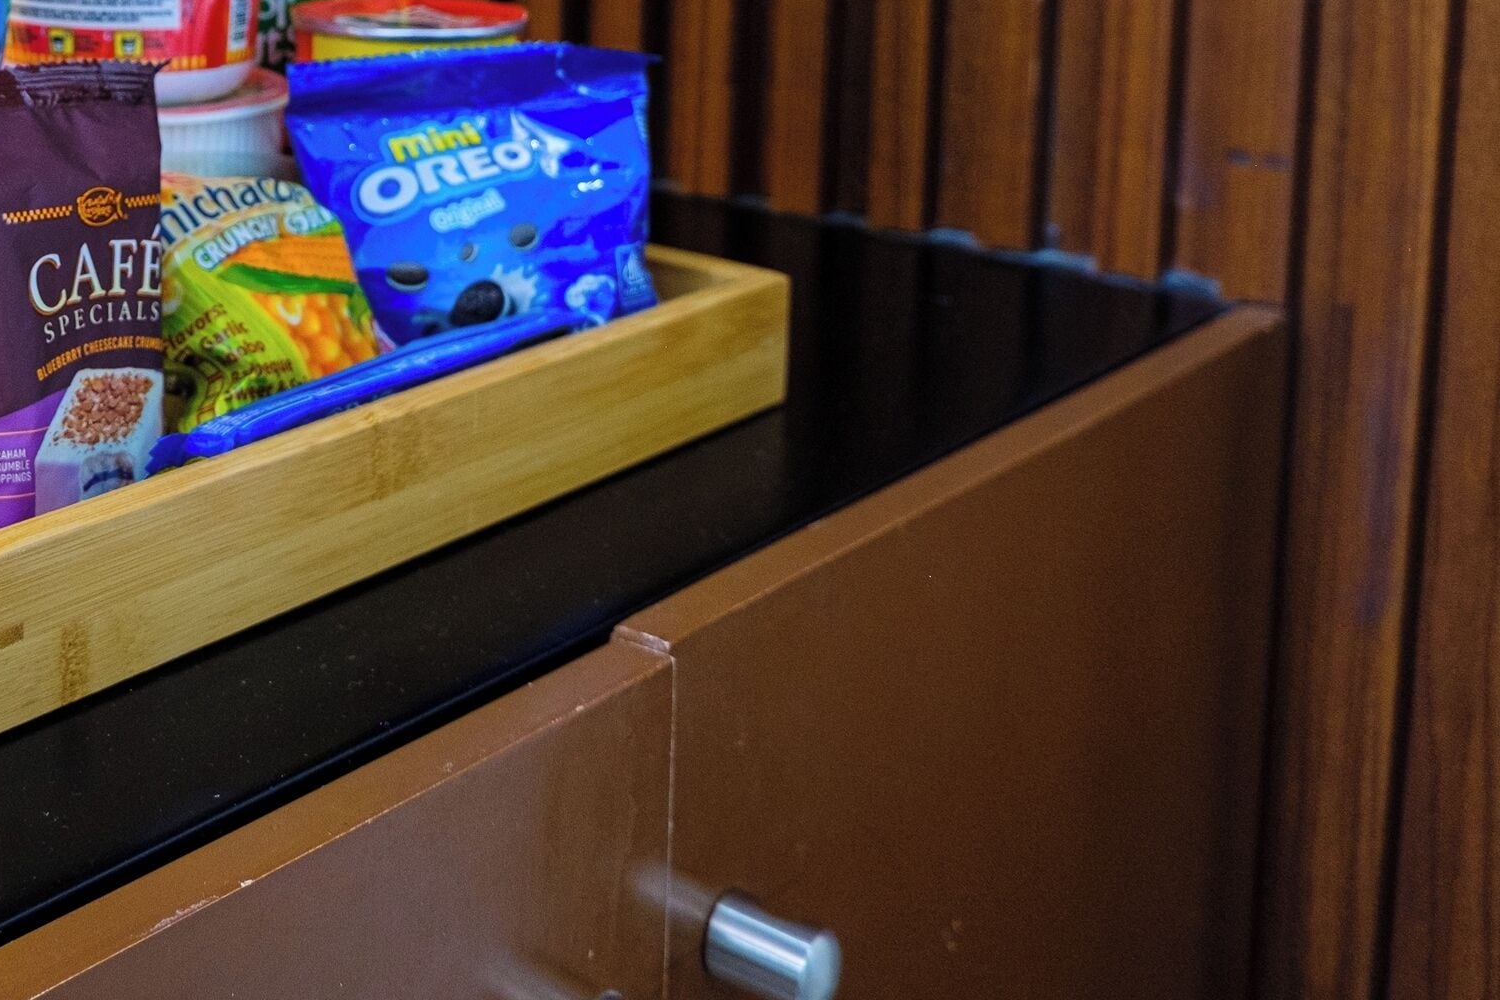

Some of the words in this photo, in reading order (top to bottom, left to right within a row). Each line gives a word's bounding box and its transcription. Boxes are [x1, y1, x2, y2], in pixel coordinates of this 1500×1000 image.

[388, 121, 483, 164] mini
[358, 140, 533, 215] OREO
[28, 223, 161, 316] CAFÉ
[43, 300, 161, 345] SPECIALS
[35, 345, 84, 382] BLUEBERRY
[83, 334, 135, 356] CHEESECAKE
